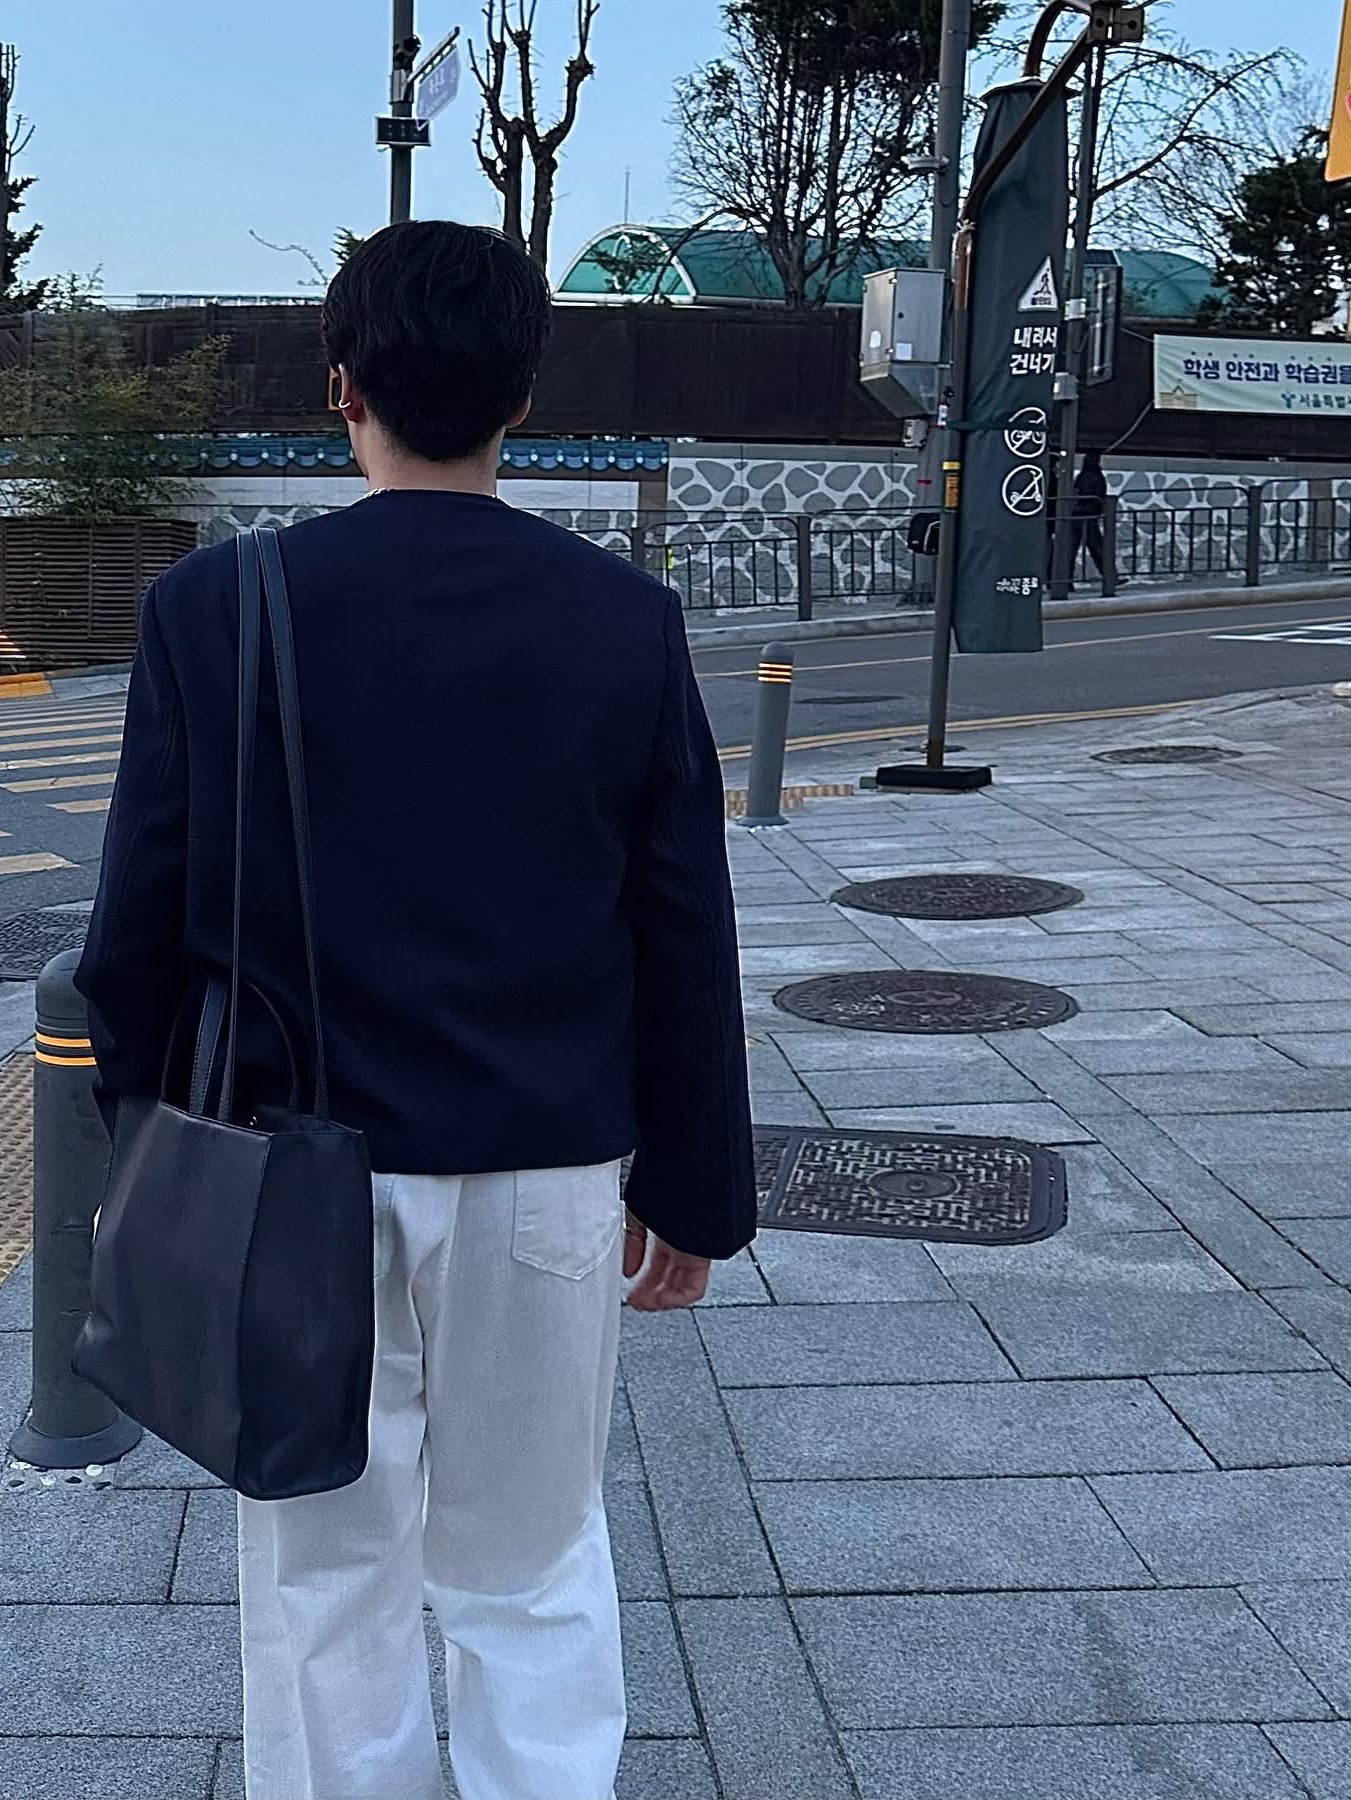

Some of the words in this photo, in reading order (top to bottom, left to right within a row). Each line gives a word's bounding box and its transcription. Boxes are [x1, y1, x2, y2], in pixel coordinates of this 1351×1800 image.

[1009, 352, 1056, 375] 건너기
[1183, 358, 1220, 380] 학생
[1225, 360, 1280, 383] 안전과
[1284, 362, 1351, 385] 학습권을
